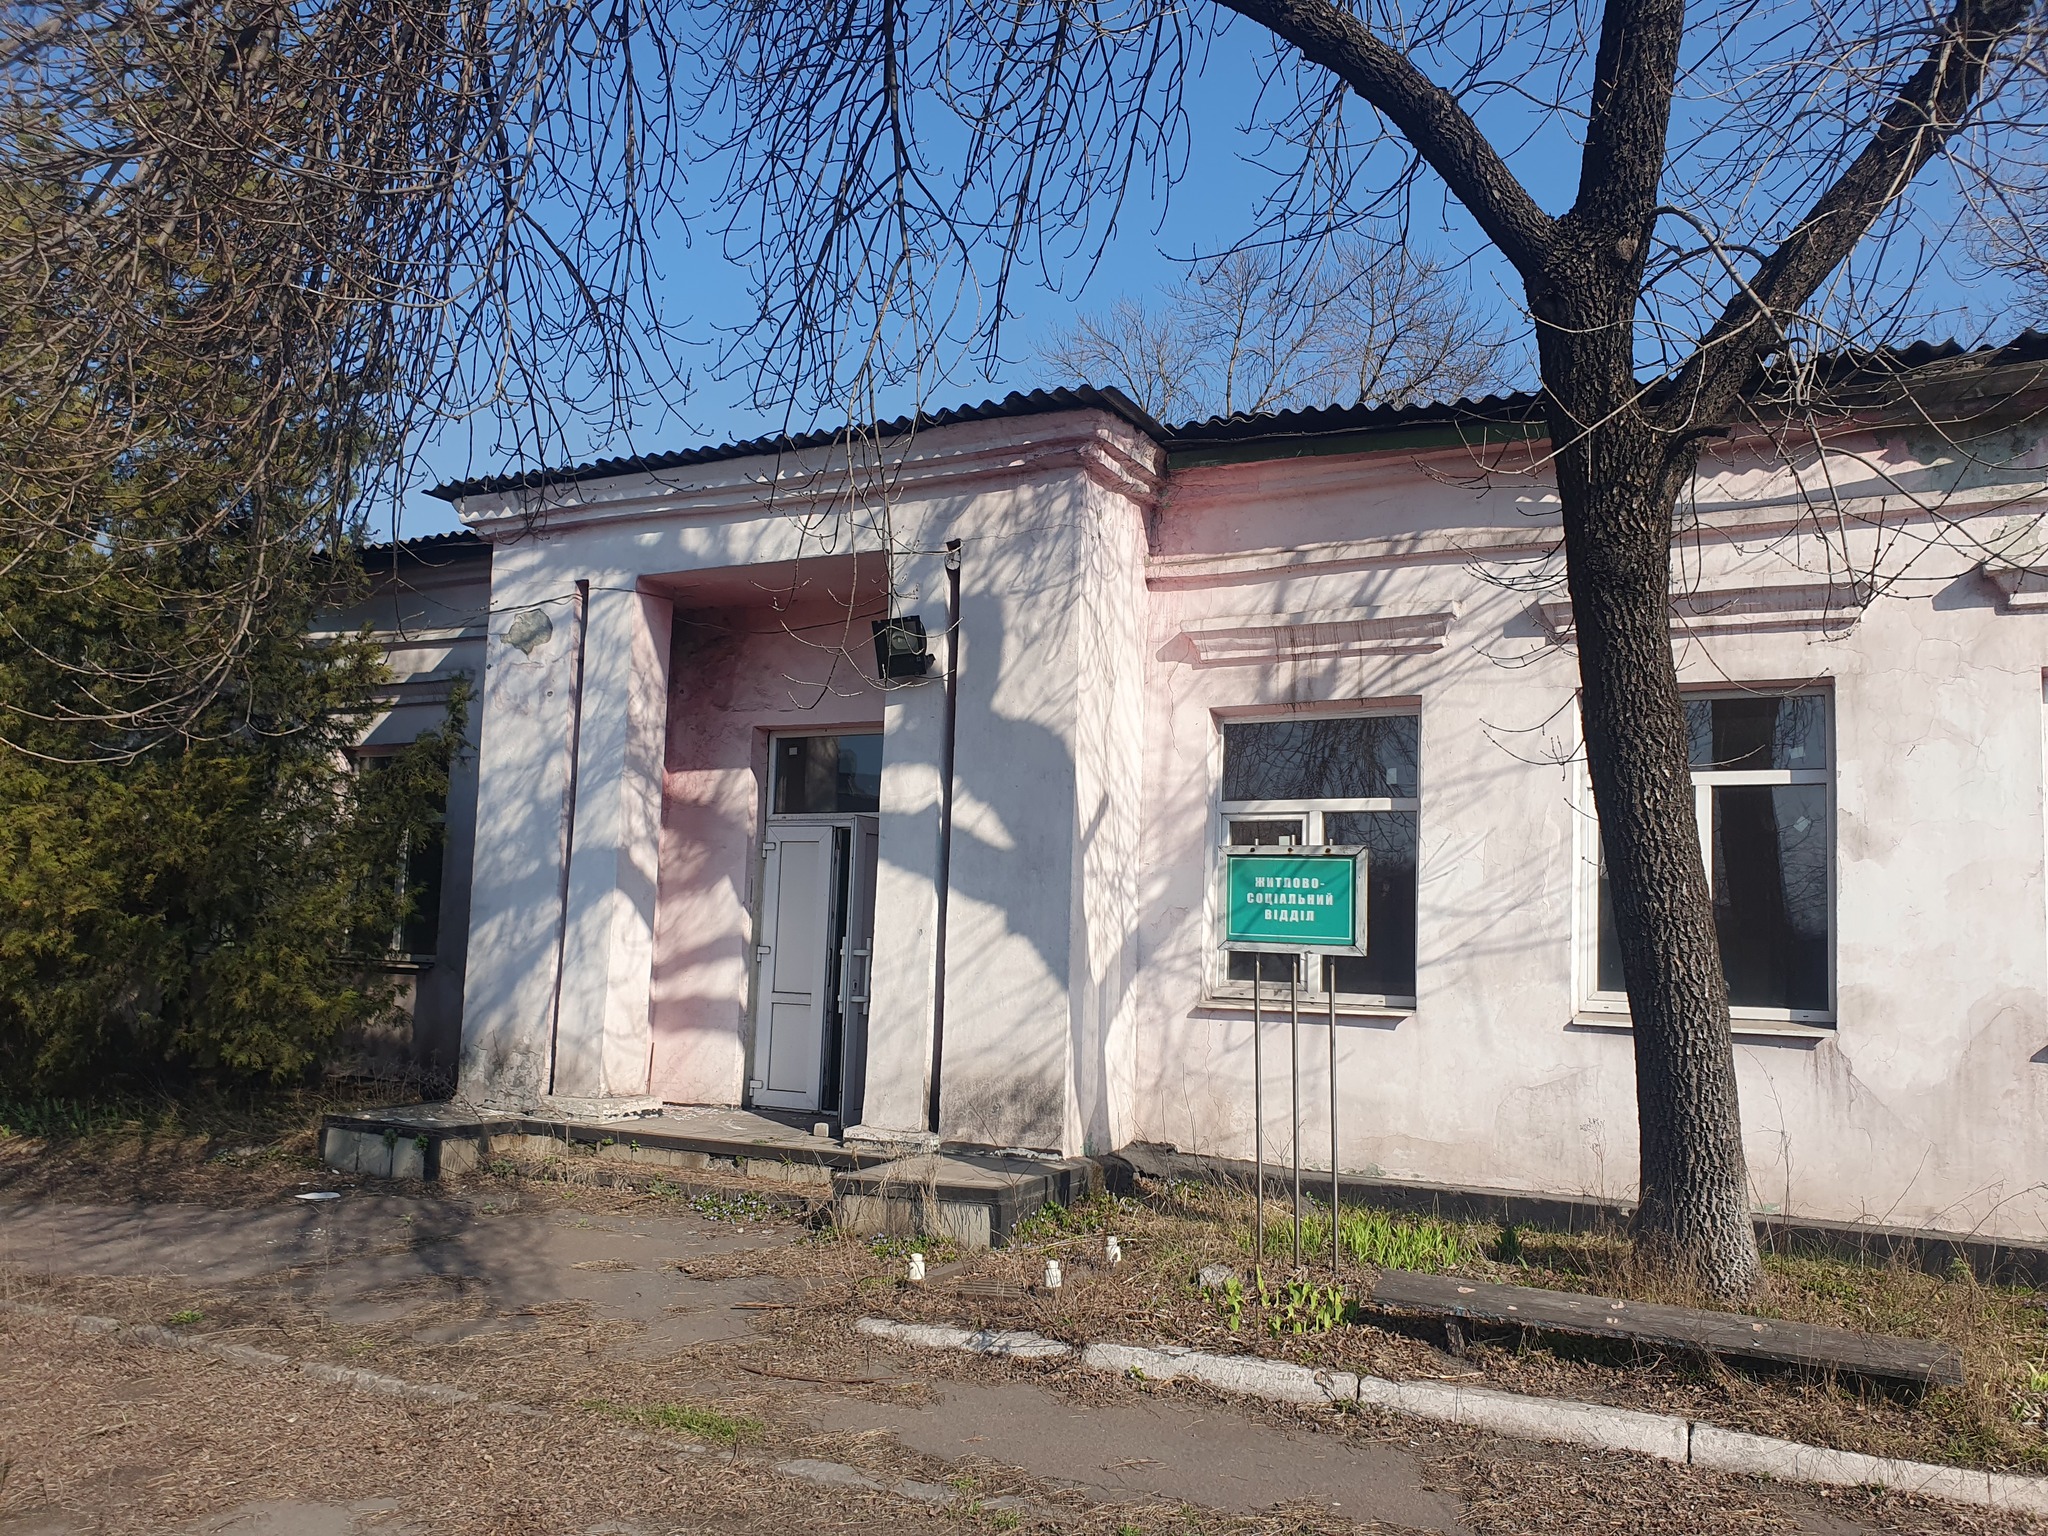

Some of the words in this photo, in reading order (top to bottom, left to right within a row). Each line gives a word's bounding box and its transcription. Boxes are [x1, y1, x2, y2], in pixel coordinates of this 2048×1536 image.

[1254, 877, 1325, 889] ЖИТЛОВО-
[1246, 892, 1334, 906] СОЦІАЛЬНИЙ
[1264, 909, 1315, 922] ВІДДІЛ
